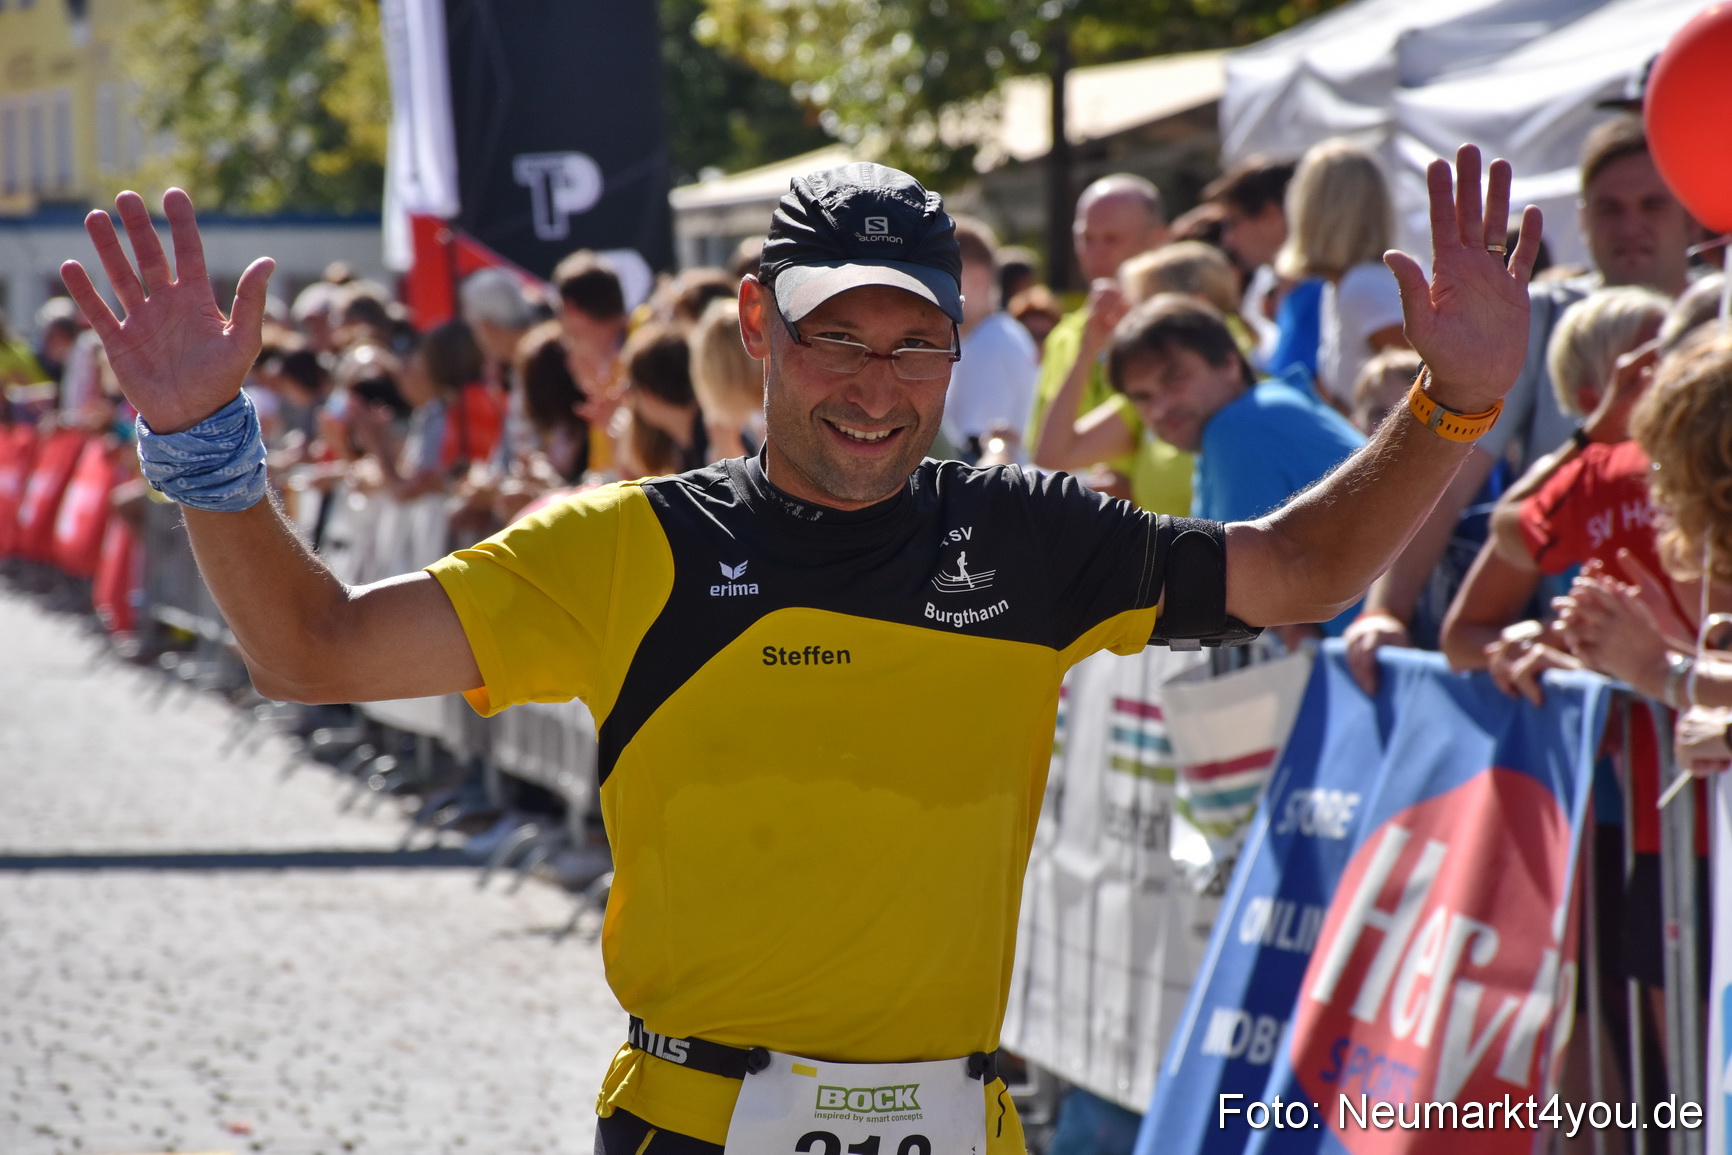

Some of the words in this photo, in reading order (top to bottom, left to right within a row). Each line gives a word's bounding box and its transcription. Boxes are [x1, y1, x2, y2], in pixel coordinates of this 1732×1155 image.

[710, 581, 759, 597] erima
[924, 599, 1009, 628] Burgthann
[762, 646, 851, 666] Steffen
[1277, 789, 1361, 838] STORE
[1200, 1007, 1289, 1066] MOB
[816, 1084, 921, 1113] BOCK
[814, 1111, 851, 1121] inspired
[853, 1113, 864, 1123] by
[866, 1114, 890, 1123] smart
[891, 1112, 923, 1122] concepts
